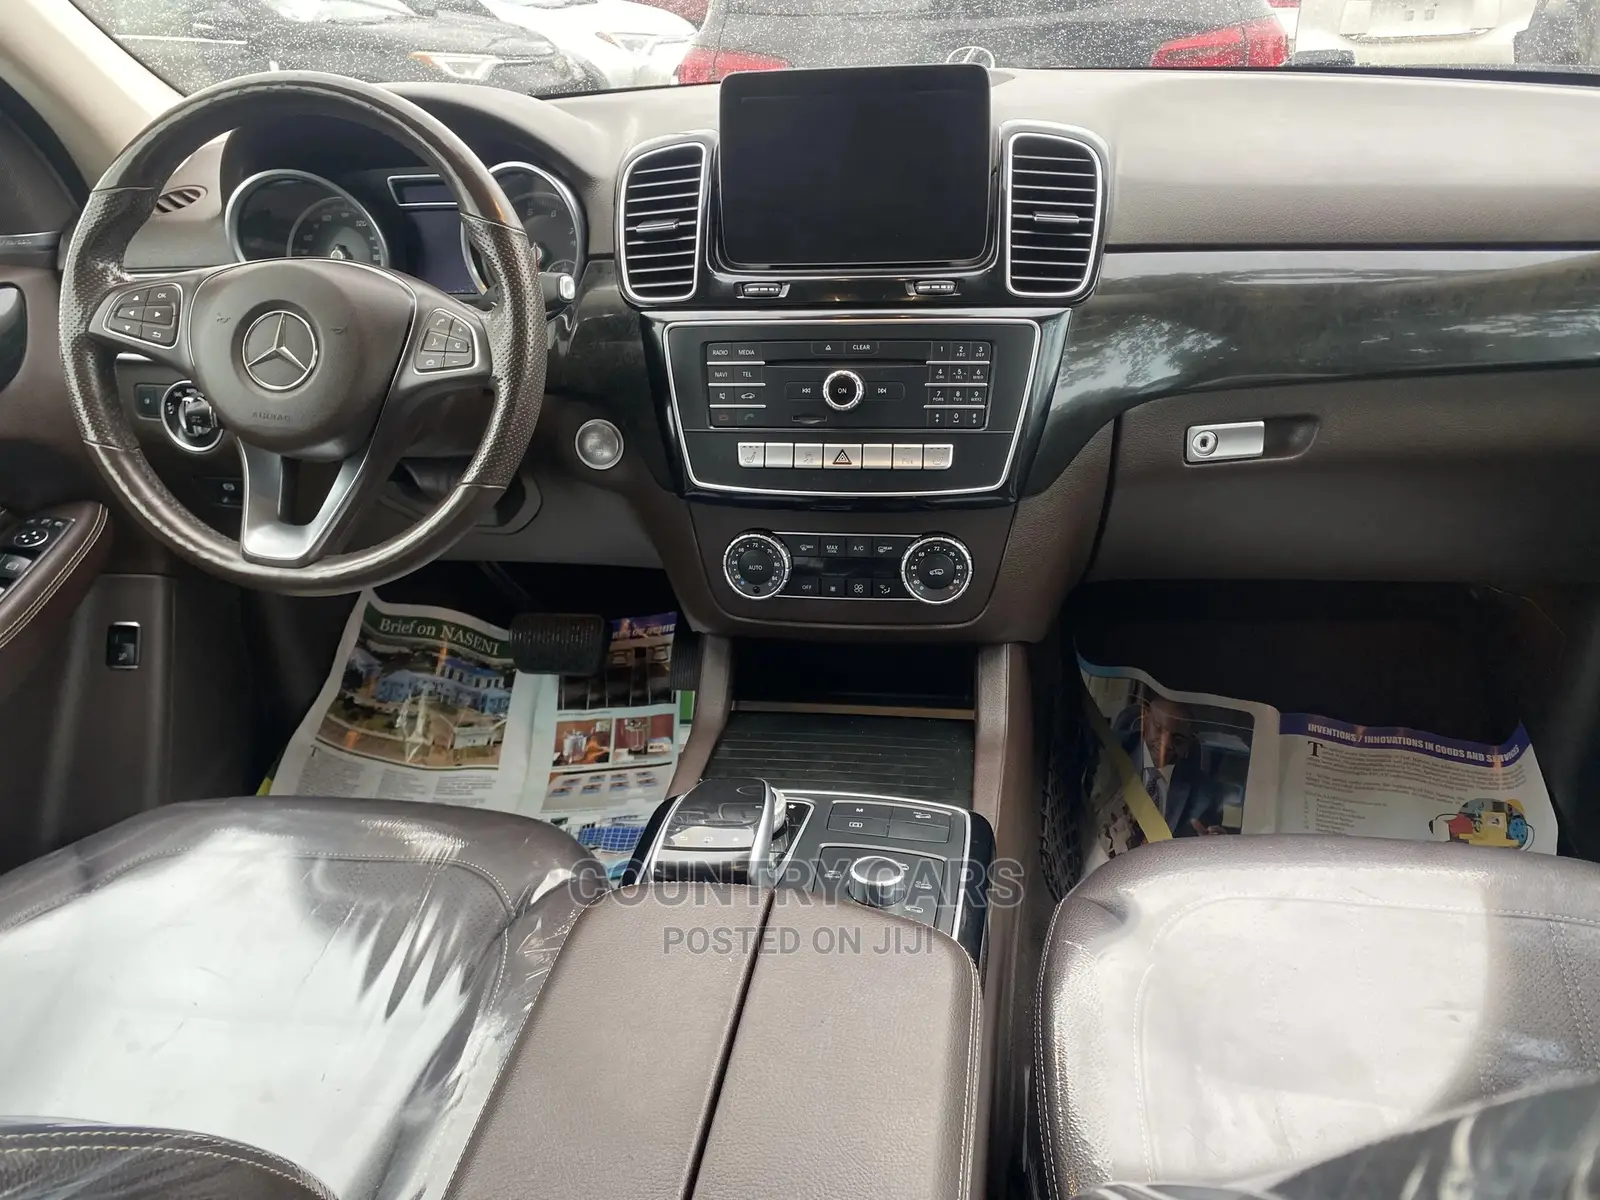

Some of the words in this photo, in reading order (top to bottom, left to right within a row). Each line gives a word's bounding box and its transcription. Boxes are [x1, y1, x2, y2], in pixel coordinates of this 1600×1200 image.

[379, 618, 418, 635] Brief
[417, 624, 436, 636] on
[441, 624, 500, 656] NASENI
[1307, 723, 1358, 743] INVENTIONS
[1364, 735, 1424, 748] INNOVATIONS
[1424, 741, 1434, 751] IN
[1434, 744, 1465, 758] GOODS
[1466, 751, 1485, 762] AND
